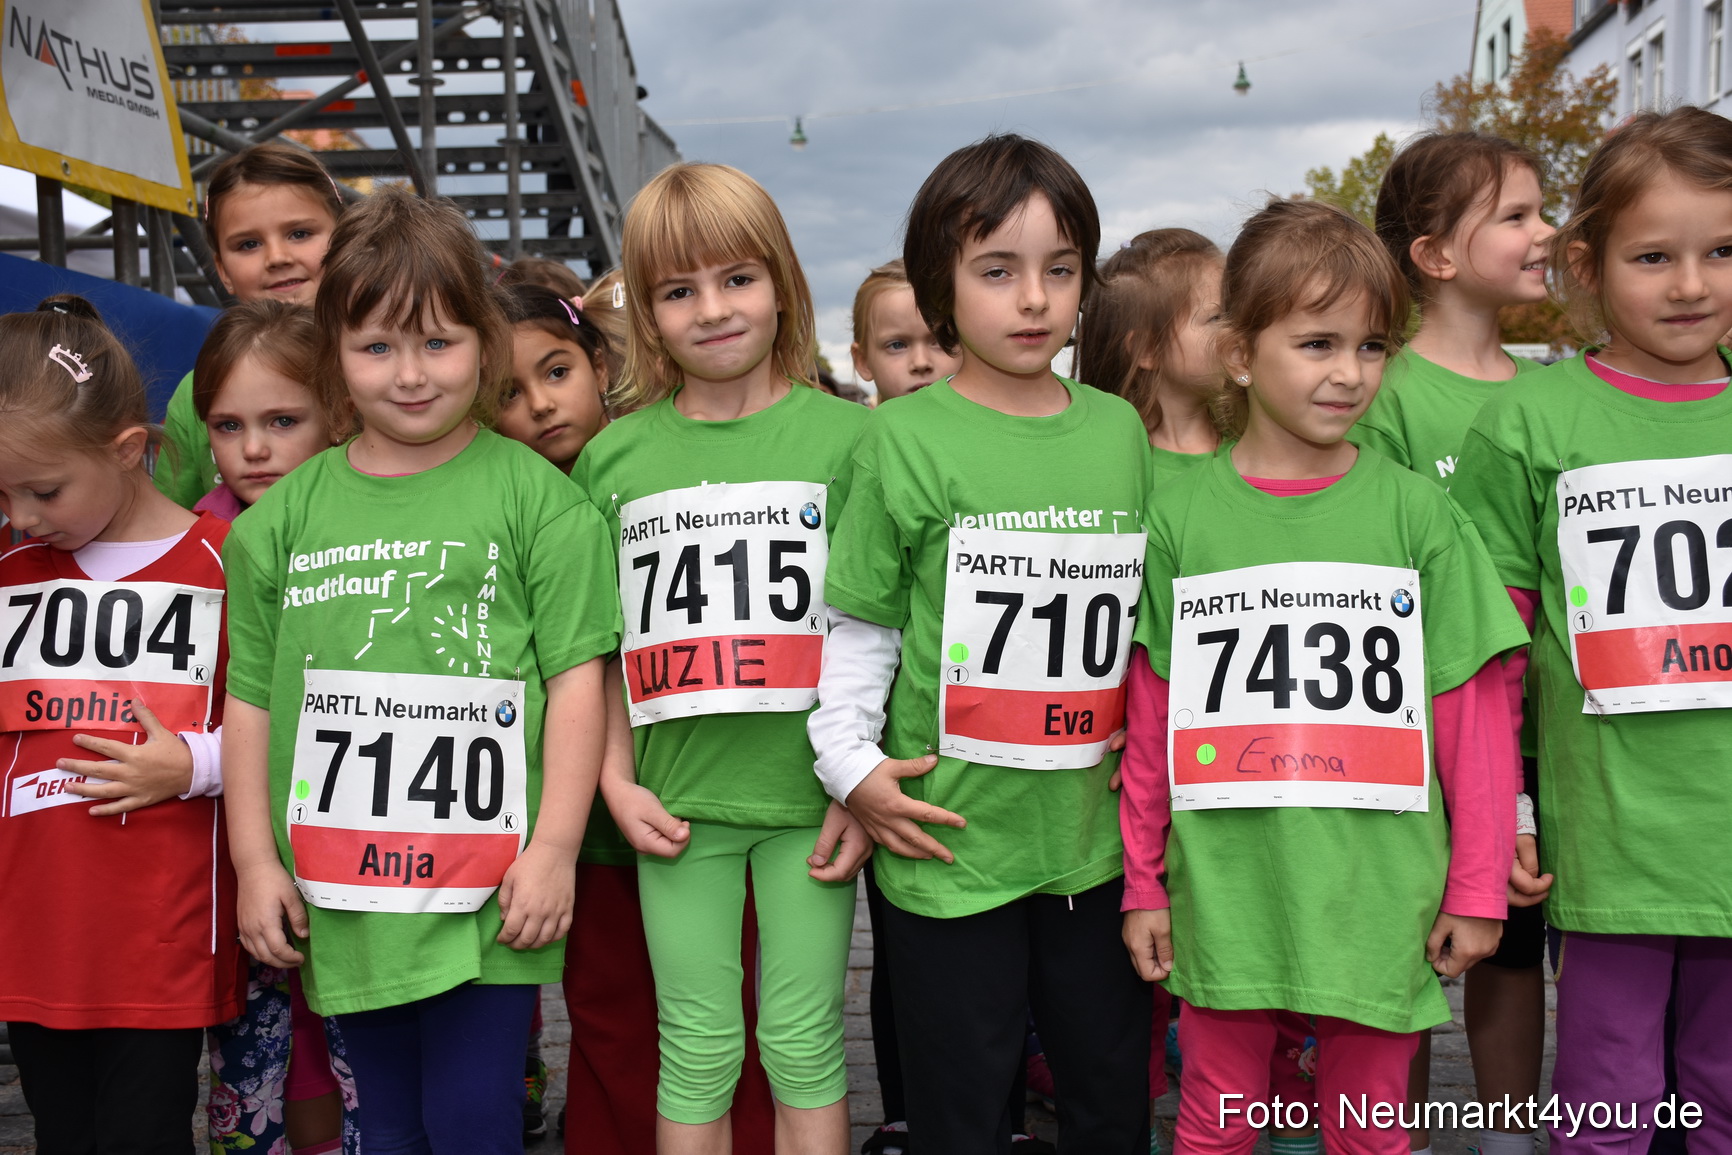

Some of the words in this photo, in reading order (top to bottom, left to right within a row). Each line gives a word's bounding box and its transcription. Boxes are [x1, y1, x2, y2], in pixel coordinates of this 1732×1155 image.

[9, 5, 155, 101] NATHUS
[86, 86, 125, 108] MEDIA
[126, 102, 160, 119] GMBH
[1435, 455, 1459, 478] N
[1564, 486, 1656, 518] PARTL
[622, 516, 670, 547] PARTL
[676, 506, 790, 531] Neumarkt
[955, 552, 1041, 578] PARTL
[1048, 558, 1144, 579] Neumark
[632, 539, 811, 634] 7415
[1180, 592, 1254, 620] PARTL
[1261, 588, 1382, 611] Neumarkt
[1, 587, 196, 671] 7004
[810, 616, 818, 630] K
[195, 667, 204, 681] K
[636, 638, 766, 697] LUZIE
[953, 668, 961, 682] 1
[1197, 622, 1404, 714] 7438
[25, 690, 138, 728] Sophia
[304, 693, 368, 717] PARTL
[374, 696, 488, 723] Neumarkt
[1044, 703, 1094, 736] Eva
[1406, 709, 1414, 723] K
[1236, 736, 1346, 777] Emma
[315, 729, 504, 822] 7140
[296, 806, 302, 821] 1
[505, 815, 513, 829] K
[358, 843, 435, 886] Anja
